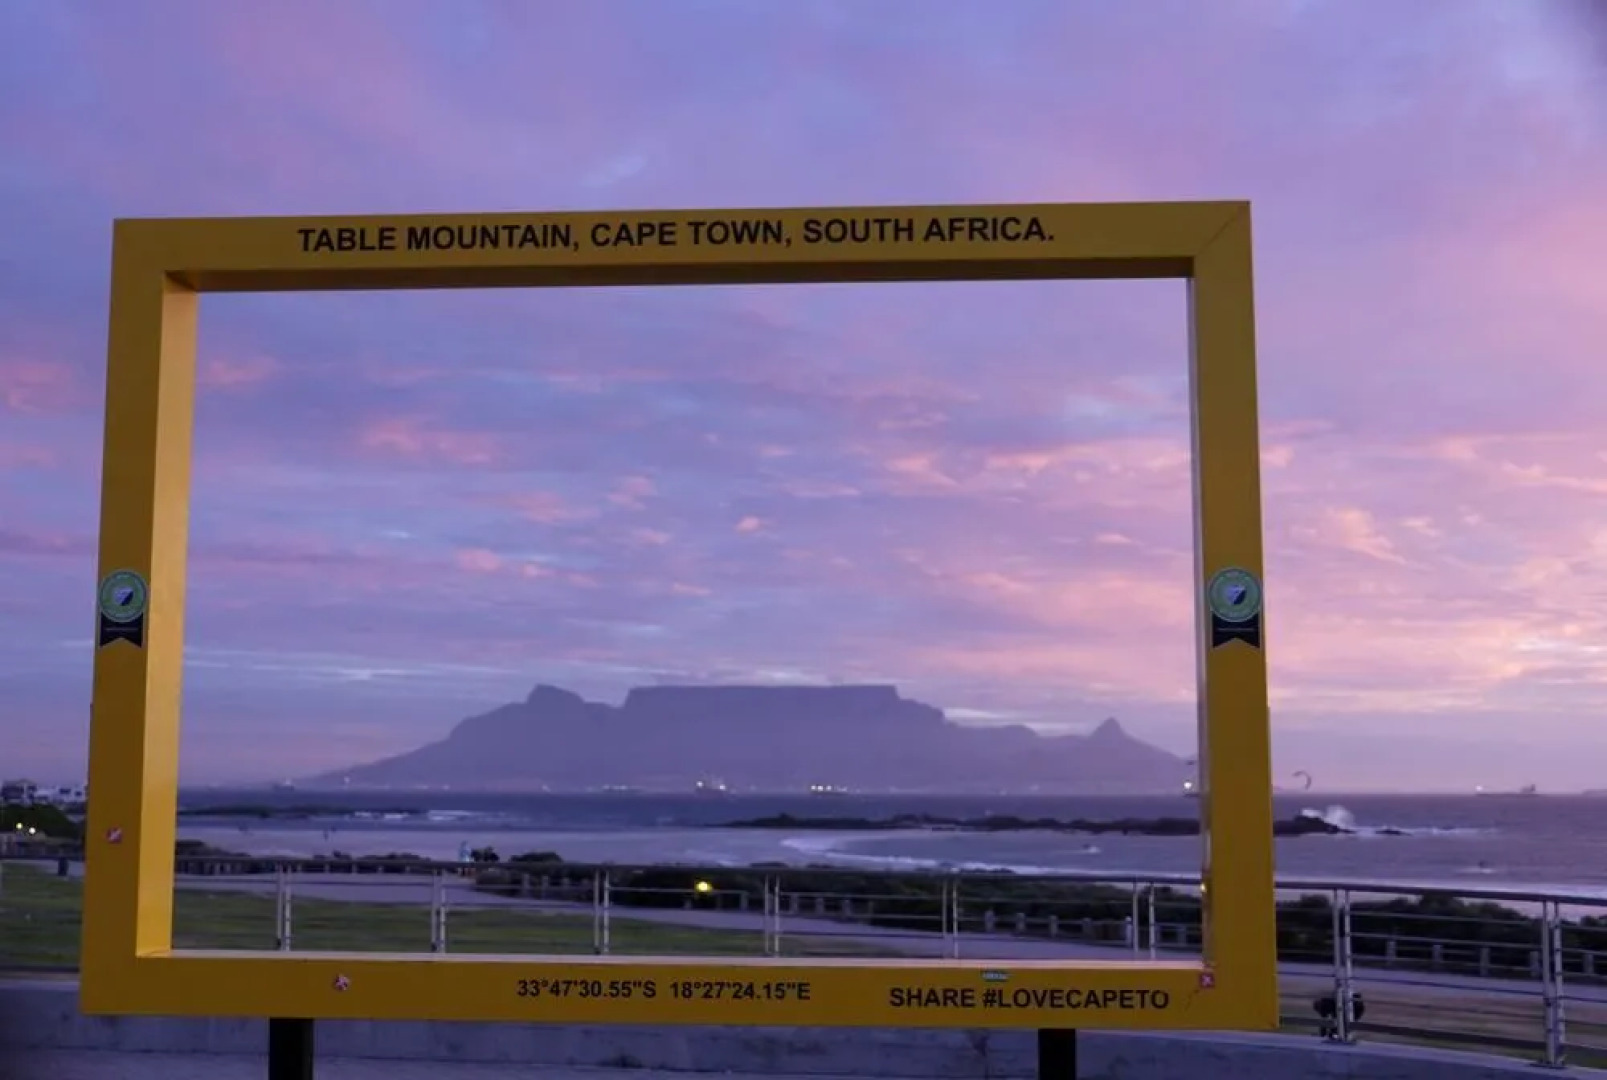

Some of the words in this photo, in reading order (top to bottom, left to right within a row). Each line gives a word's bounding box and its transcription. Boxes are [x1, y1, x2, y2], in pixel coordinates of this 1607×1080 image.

[297, 227, 397, 252] TABLE
[407, 224, 579, 251] MOUNTAIN,
[590, 222, 677, 247] CAPE
[687, 219, 792, 247] TOWN,
[803, 218, 914, 244] SOUTH
[923, 216, 1054, 242] AFRICA.
[889, 987, 977, 1008] SHARE
[982, 988, 1169, 1010] #LOVECAPETO
